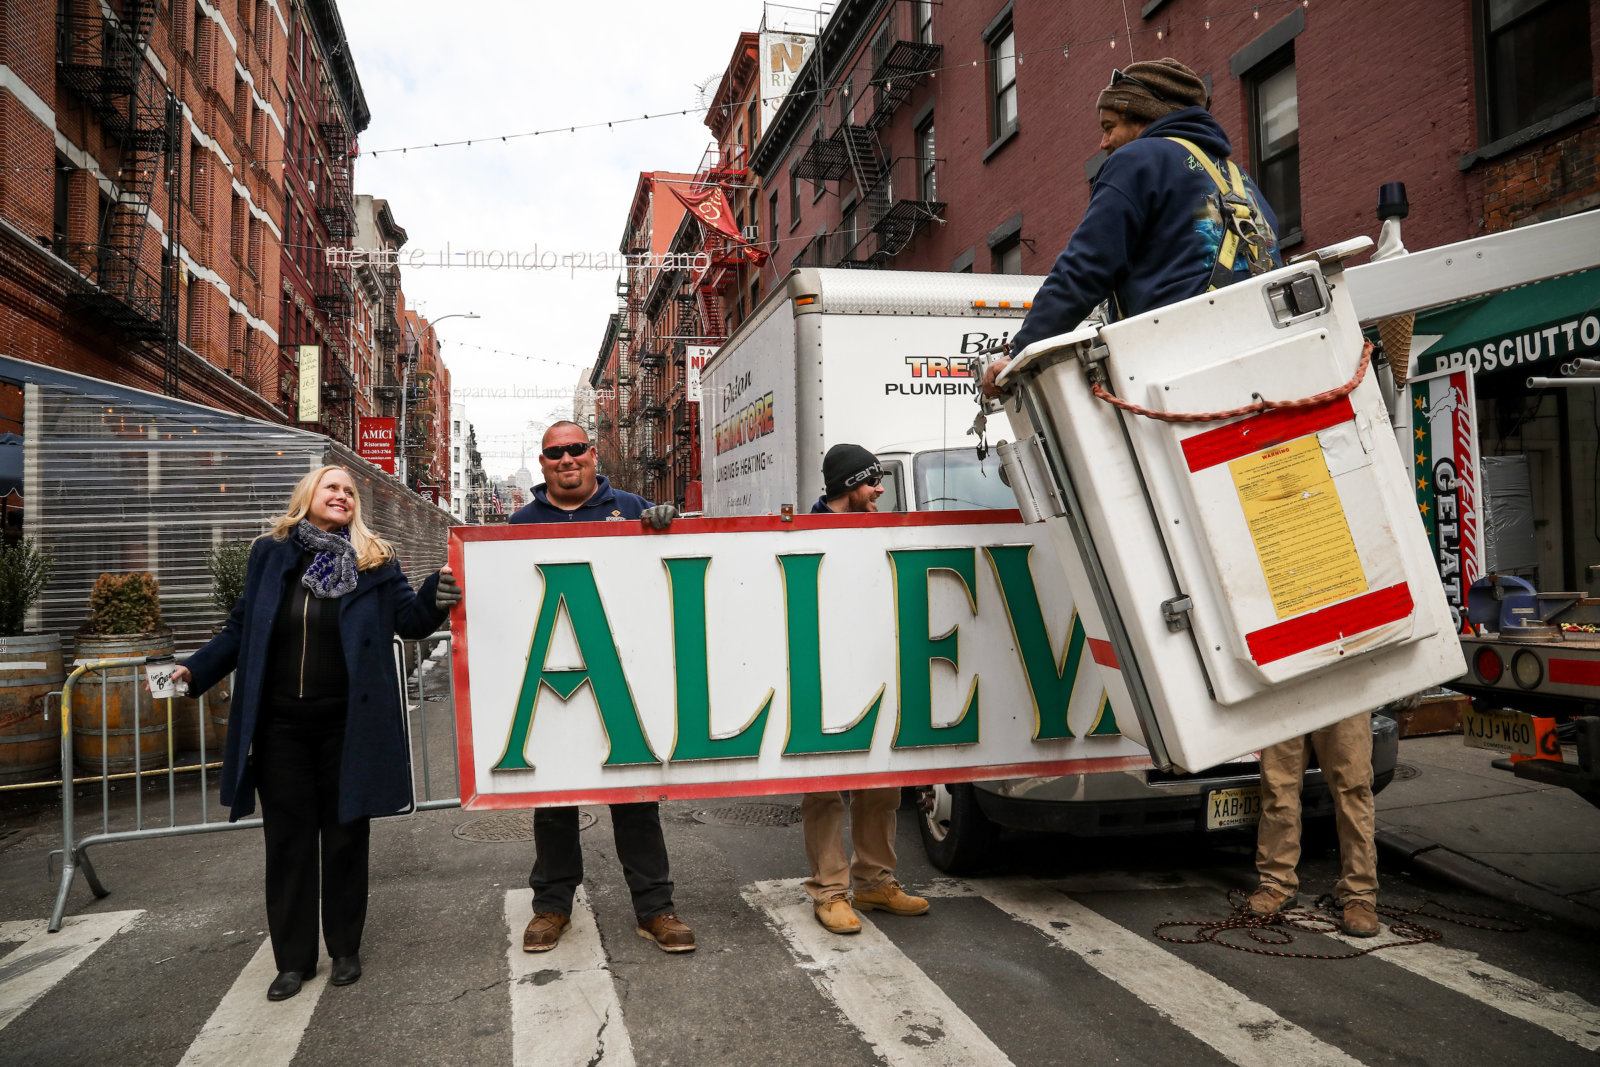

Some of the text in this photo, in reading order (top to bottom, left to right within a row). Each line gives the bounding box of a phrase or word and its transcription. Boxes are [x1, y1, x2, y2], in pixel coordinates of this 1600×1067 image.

[466, 242, 557, 271] mondo
[960, 331, 1009, 354] Bri
[1436, 315, 1600, 374] PROSCIUTTO
[885, 383, 979, 395] PLUMBIN
[361, 428, 392, 439] AMICI
[844, 462, 884, 487] carh
[491, 541, 1122, 772] ALLEV
